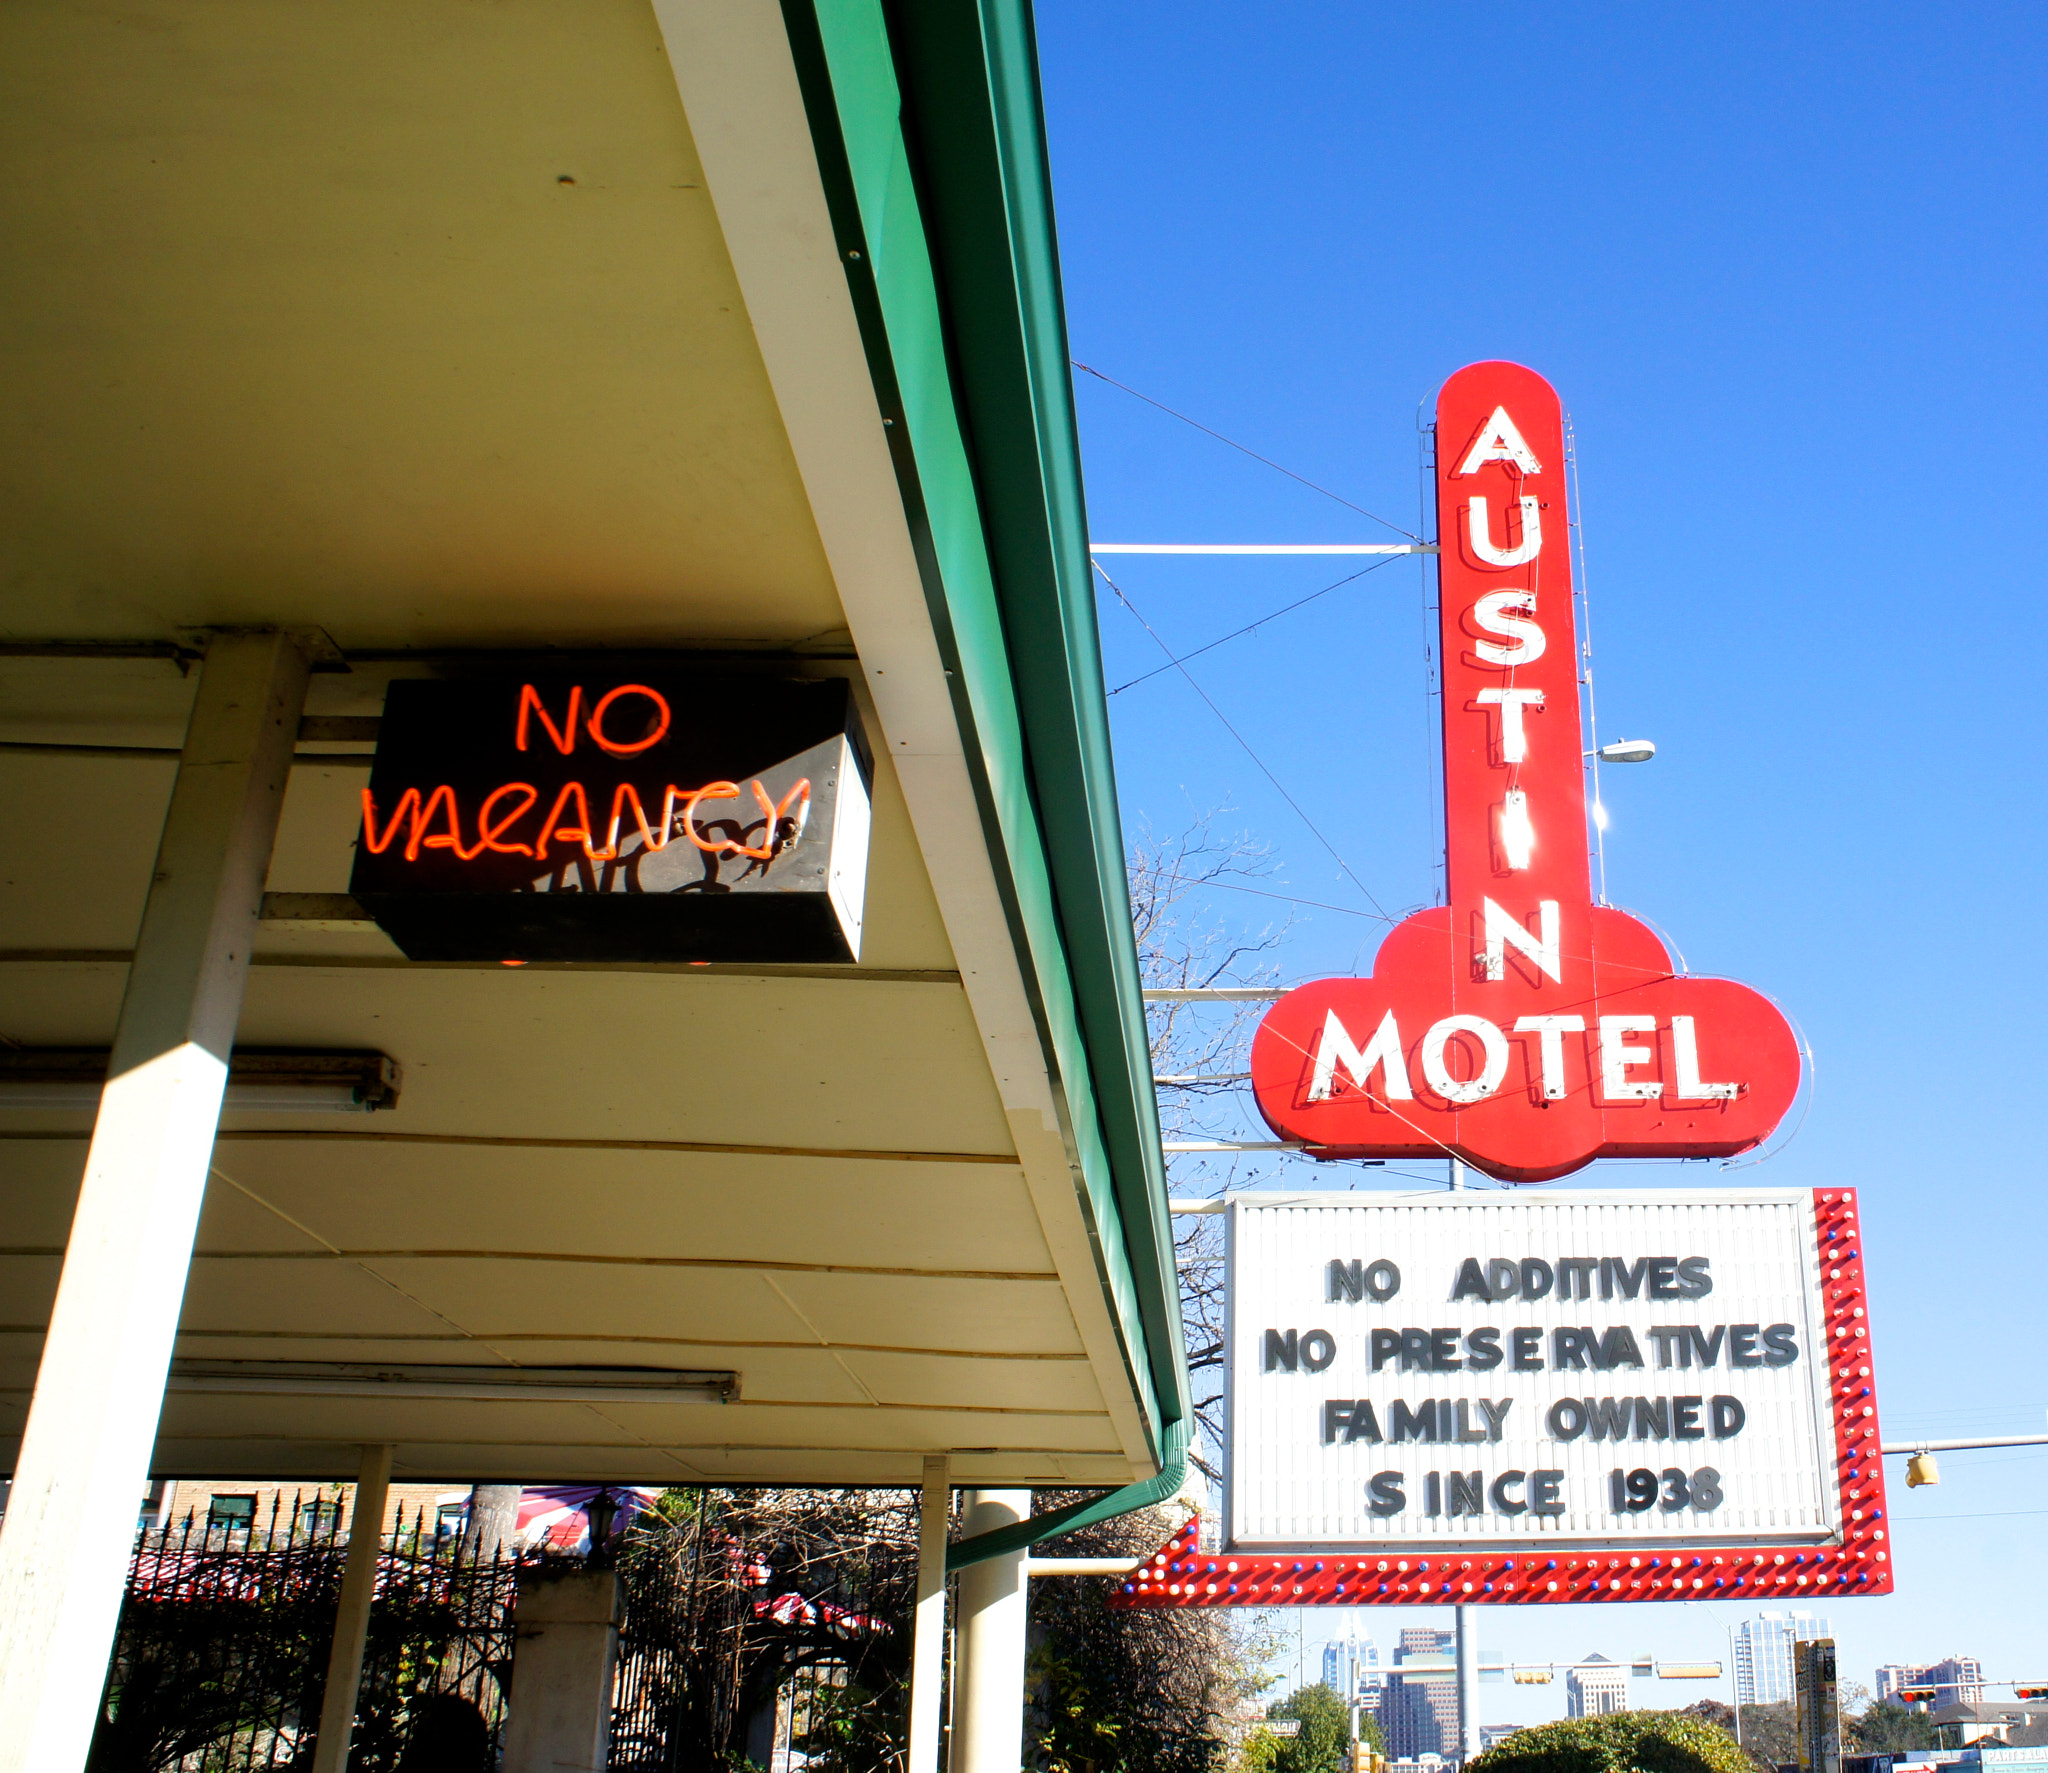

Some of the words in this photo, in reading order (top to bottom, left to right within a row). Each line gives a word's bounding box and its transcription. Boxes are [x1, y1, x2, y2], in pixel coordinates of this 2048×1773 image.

[515, 683, 671, 755] NO
[1459, 405, 1562, 984] AUSTIN
[361, 777, 811, 861] VACANCY
[1306, 1007, 1748, 1102] MOTEL
[1329, 1258, 1401, 1302] NO
[1453, 1256, 1713, 1301] ADDITIVES
[1264, 1327, 1337, 1372] NO
[1371, 1323, 1799, 1371] PRESERVATIVES
[1324, 1396, 1513, 1443] FAMILY
[1548, 1394, 1746, 1440] OWNED
[1369, 1469, 1566, 1516] SINCE
[1612, 1466, 1724, 1511] 1938
[1987, 1749, 2024, 1762] PARTS
